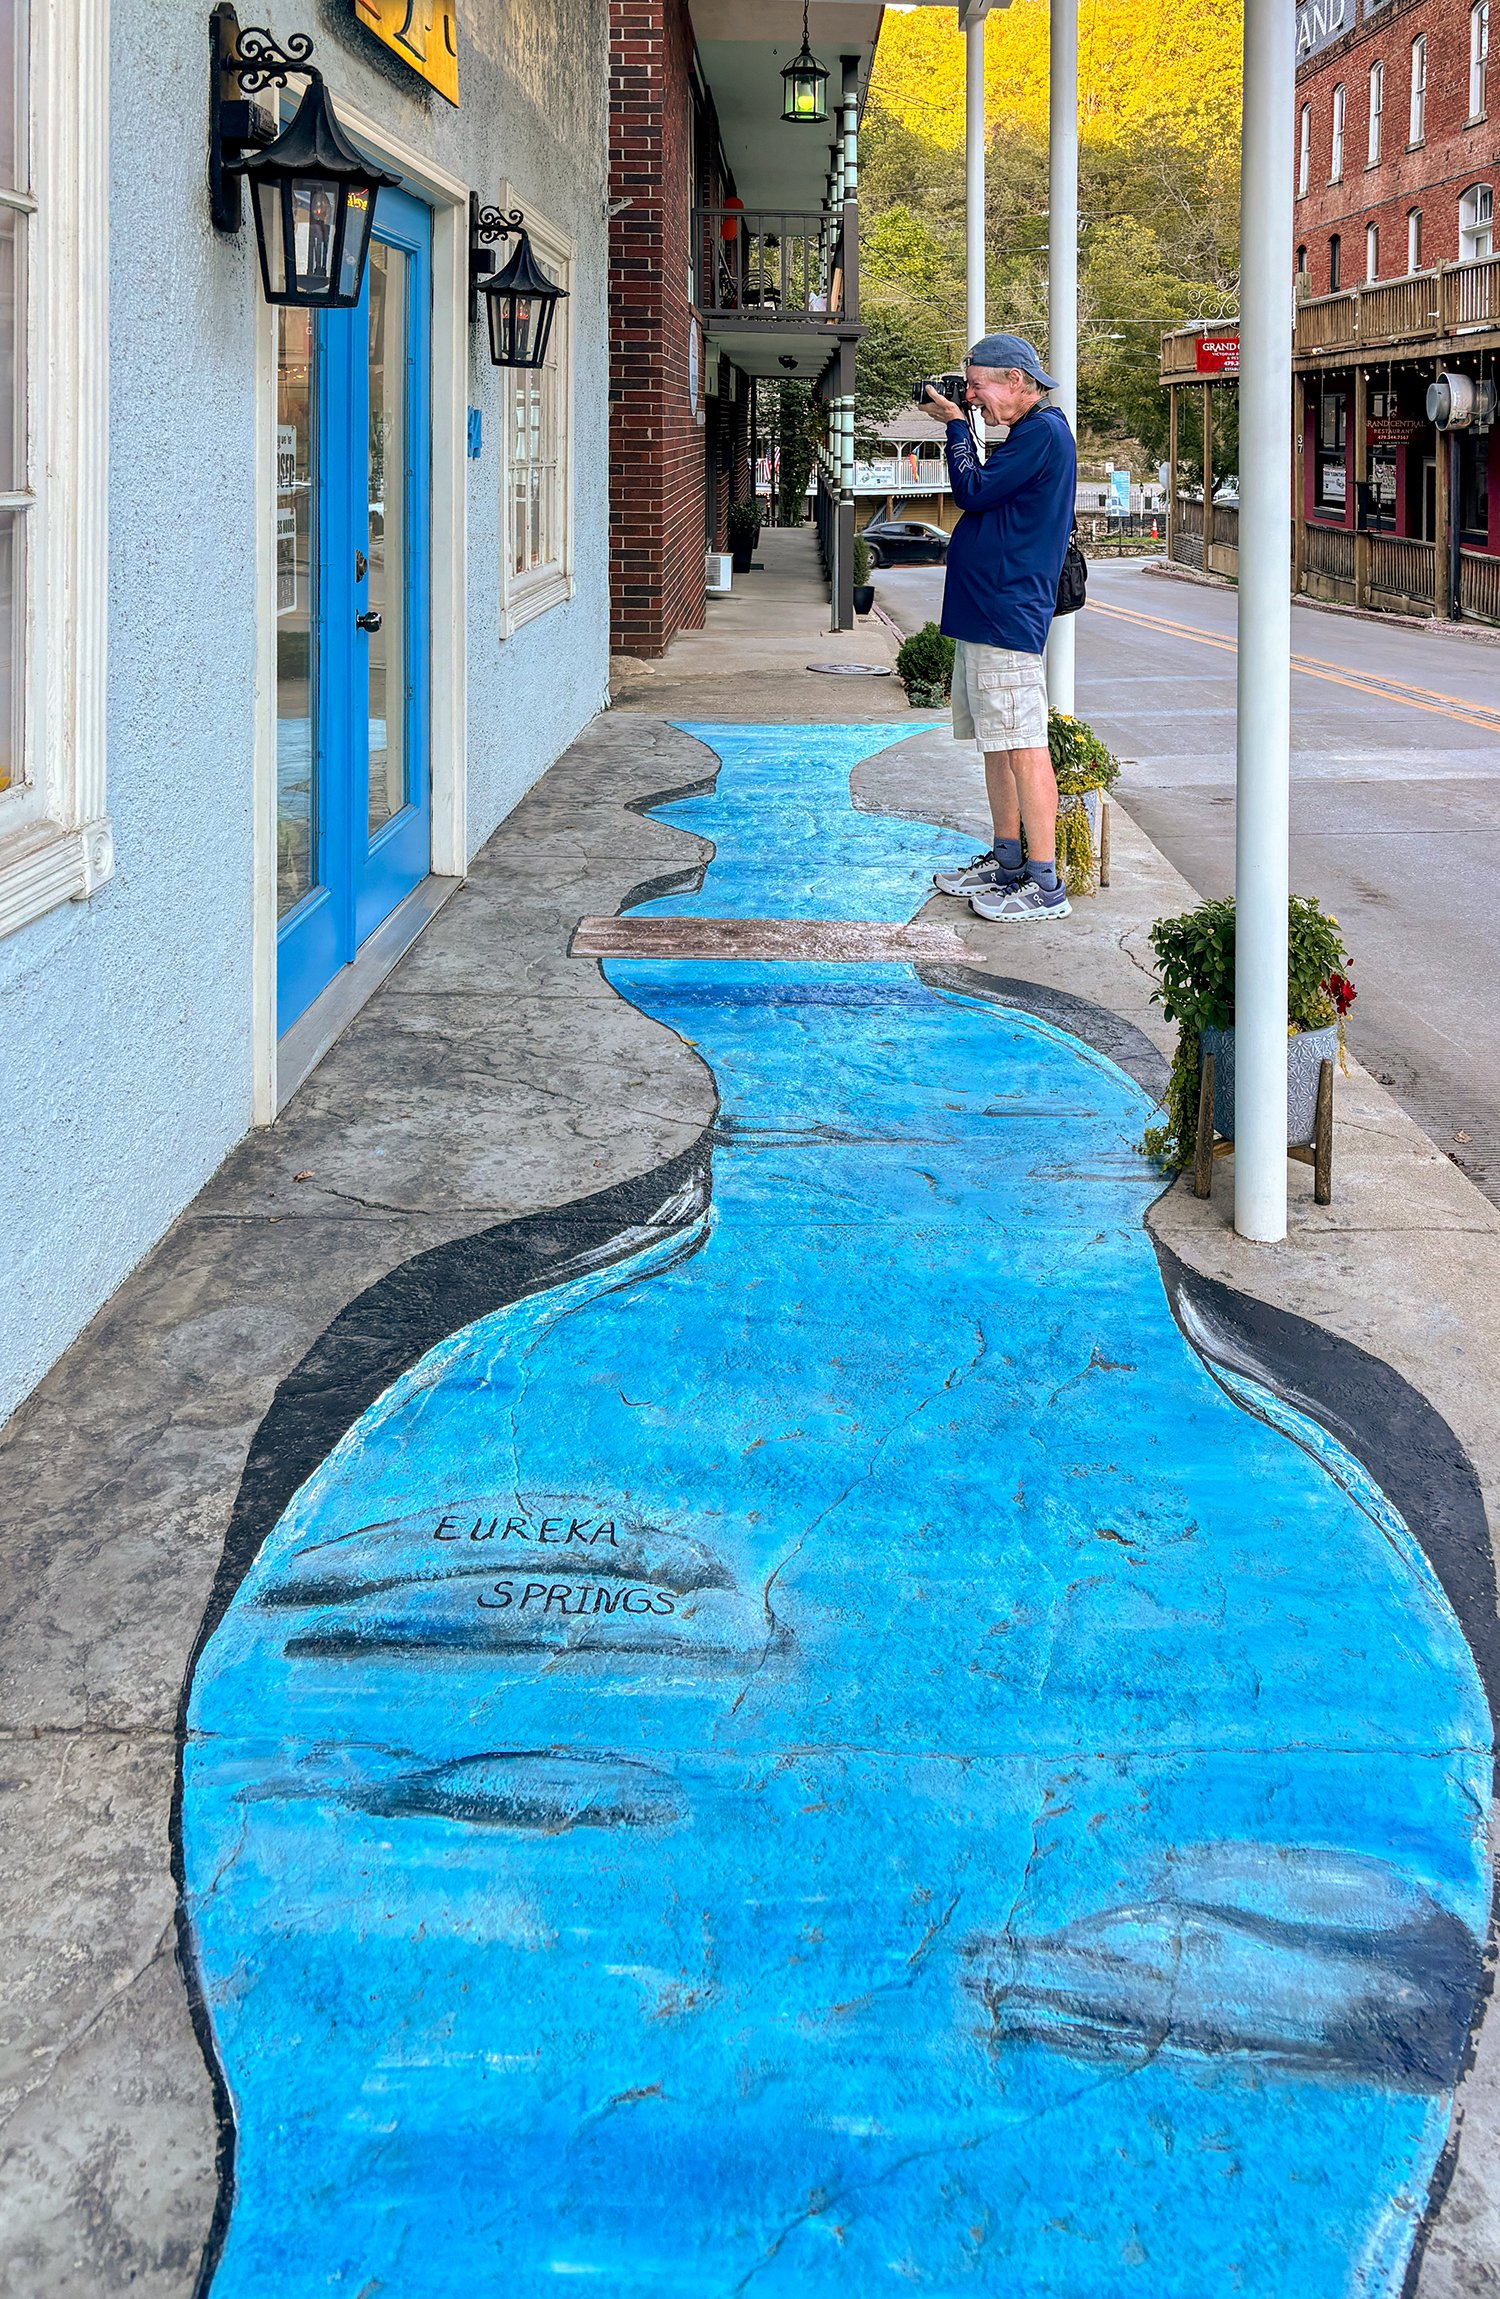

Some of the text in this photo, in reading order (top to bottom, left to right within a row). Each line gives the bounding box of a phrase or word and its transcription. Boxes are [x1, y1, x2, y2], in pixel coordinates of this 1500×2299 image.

[1202, 342, 1236, 352] GRAND
[1366, 420, 1426, 428] RAND CENTRAL
[433, 1515, 619, 1547] EUREKA
[477, 1581, 679, 1615] SPRINGS
